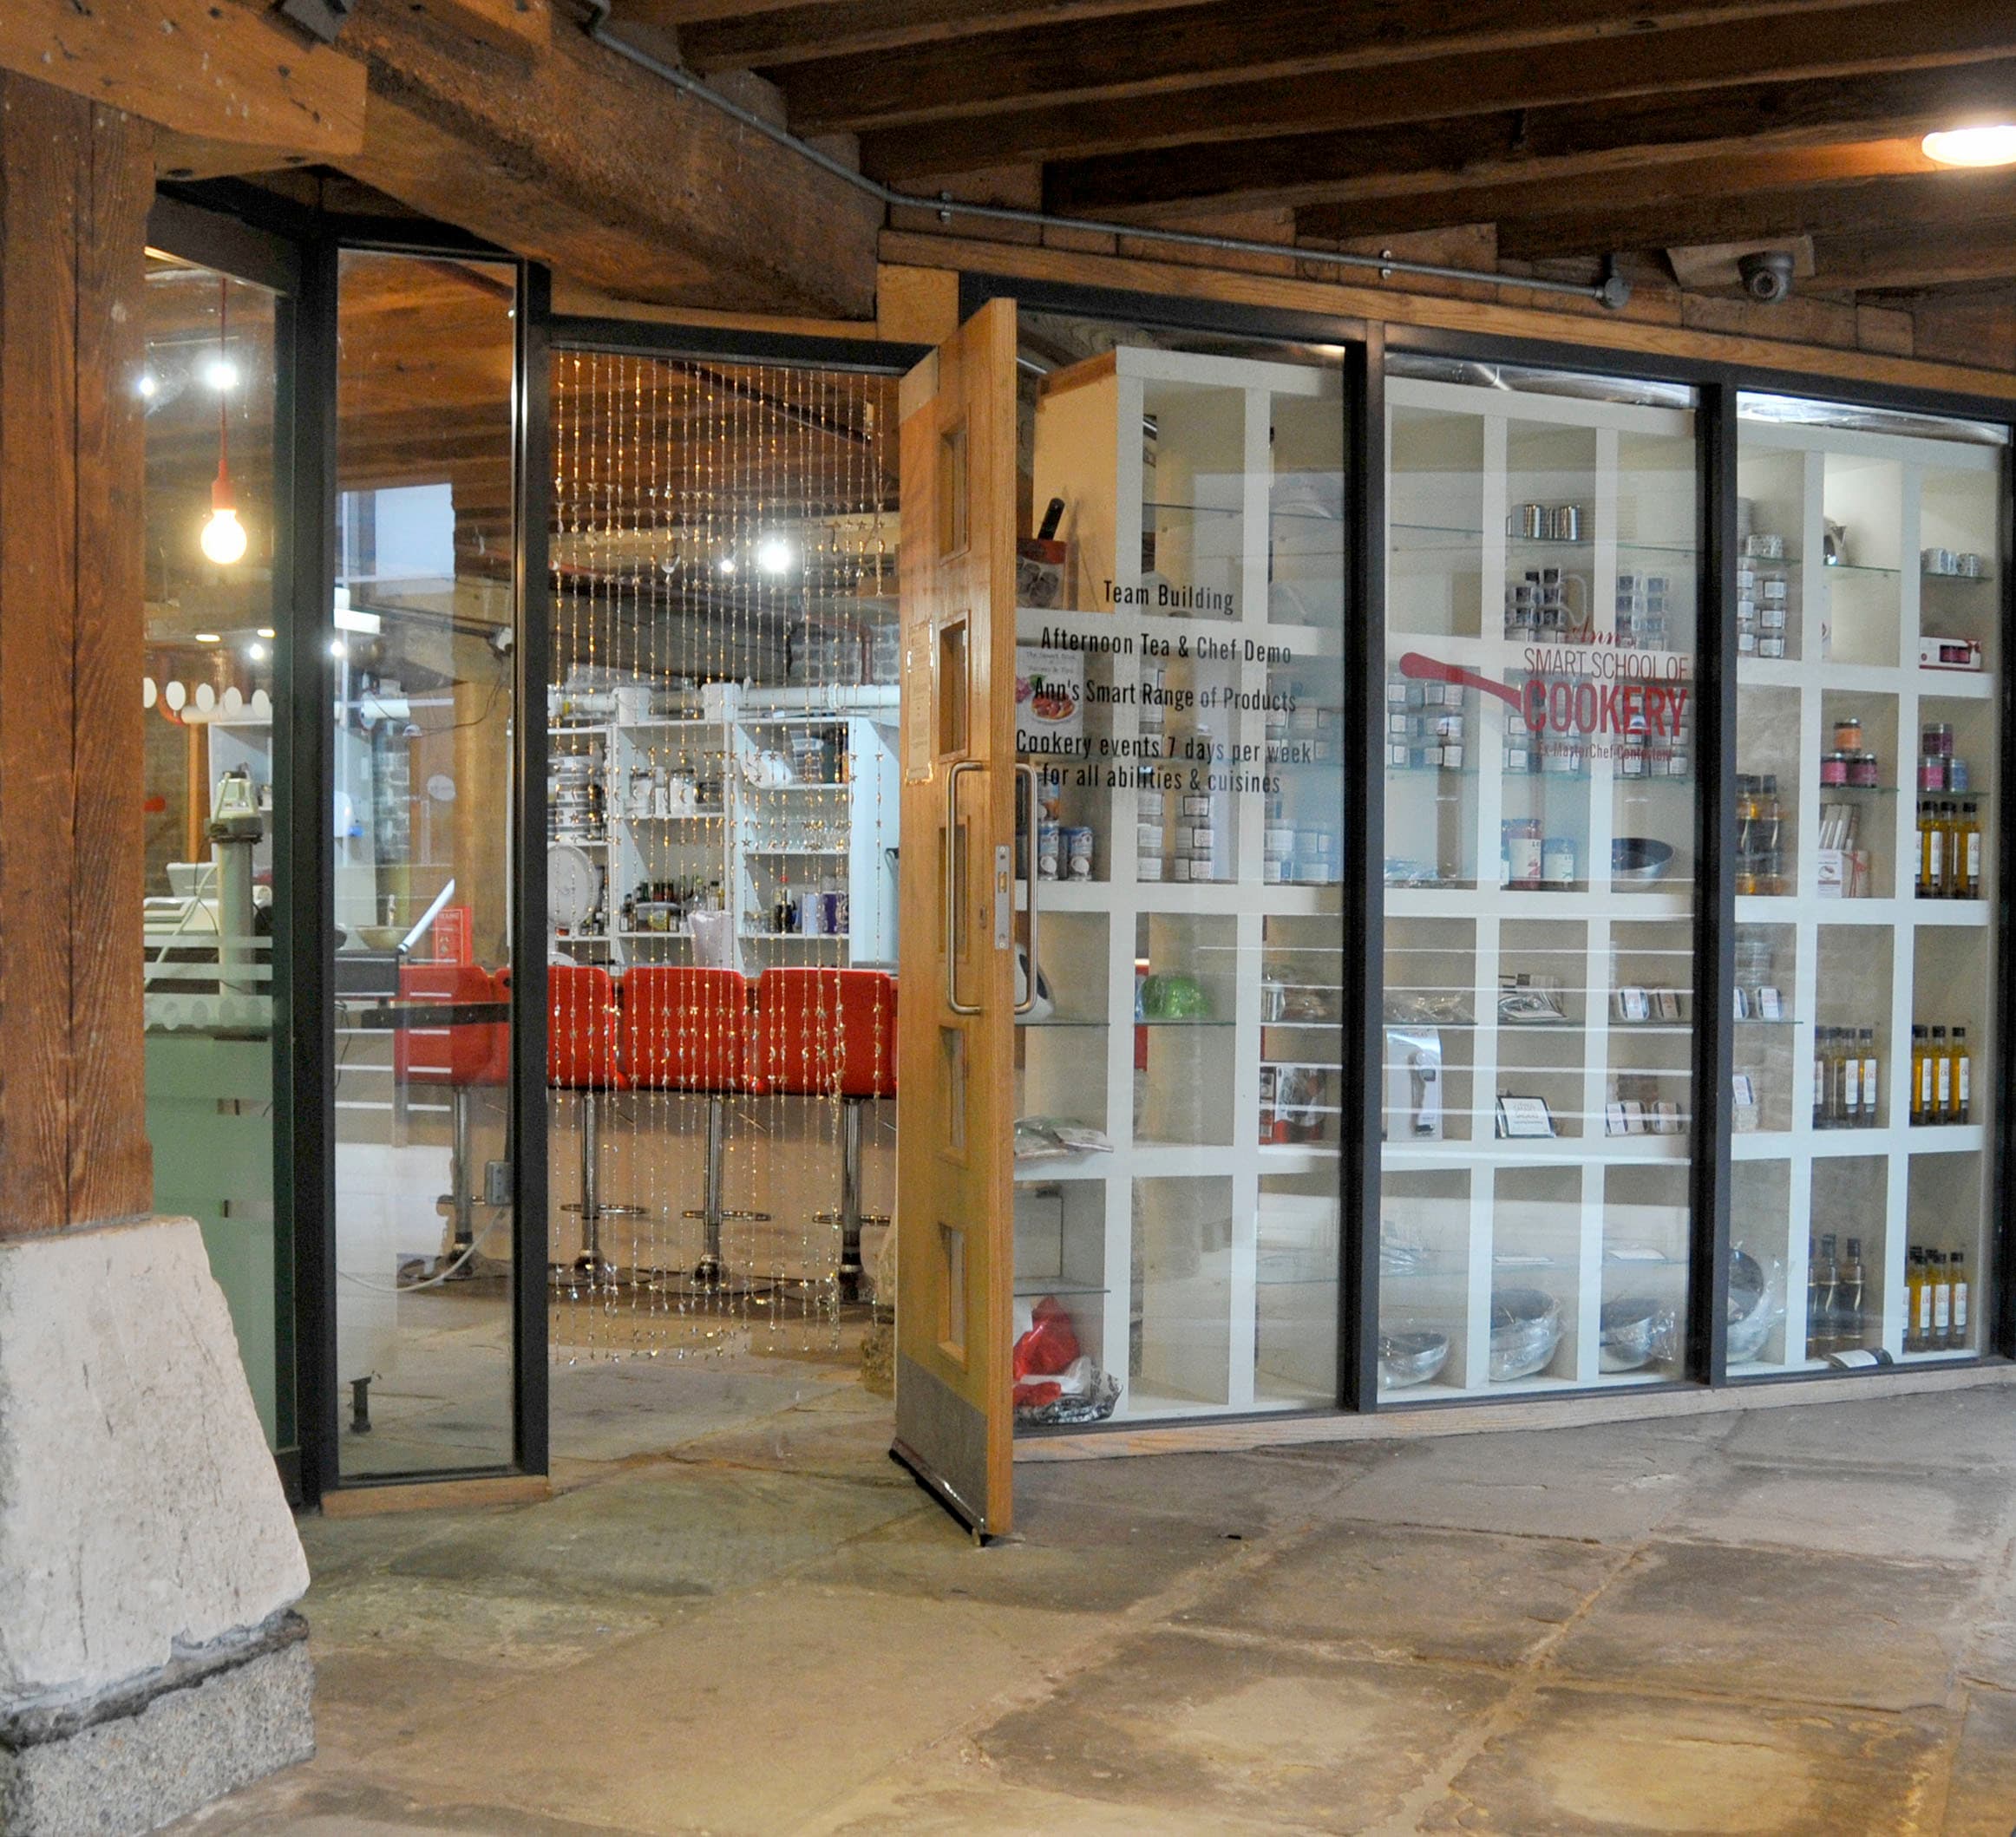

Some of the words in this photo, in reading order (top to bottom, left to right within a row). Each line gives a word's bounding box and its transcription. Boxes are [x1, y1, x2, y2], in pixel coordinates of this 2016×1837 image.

[1103, 580, 1149, 605] Team
[1158, 584, 1234, 615] Building
[1041, 626, 1133, 654] Afternoon
[1141, 633, 1170, 657] Tea
[1178, 636, 1189, 657] &
[1197, 636, 1237, 660] Chef
[1245, 639, 1292, 664] Demo
[1523, 647, 1587, 677] SMART
[1591, 651, 1661, 682] SCHOOL
[1666, 656, 1689, 682] OF
[1034, 677, 1080, 701] Ann's
[1086, 679, 1136, 704] Smart
[1142, 682, 1195, 711] Range
[1200, 687, 1216, 708] of
[1223, 688, 1297, 713] Products
[1522, 679, 1688, 737] COOKERY
[1016, 729, 1092, 759] Cookery
[1099, 736, 1160, 758] events
[1167, 736, 1176, 756] 7
[1185, 738, 1225, 766] days
[1232, 742, 1260, 768] per
[1266, 742, 1312, 765] week
[1042, 763, 1070, 787] for
[1076, 766, 1099, 788] all
[1107, 767, 1182, 791] abilities
[1190, 768, 1201, 791] &
[1208, 770, 1280, 794] cuisines
